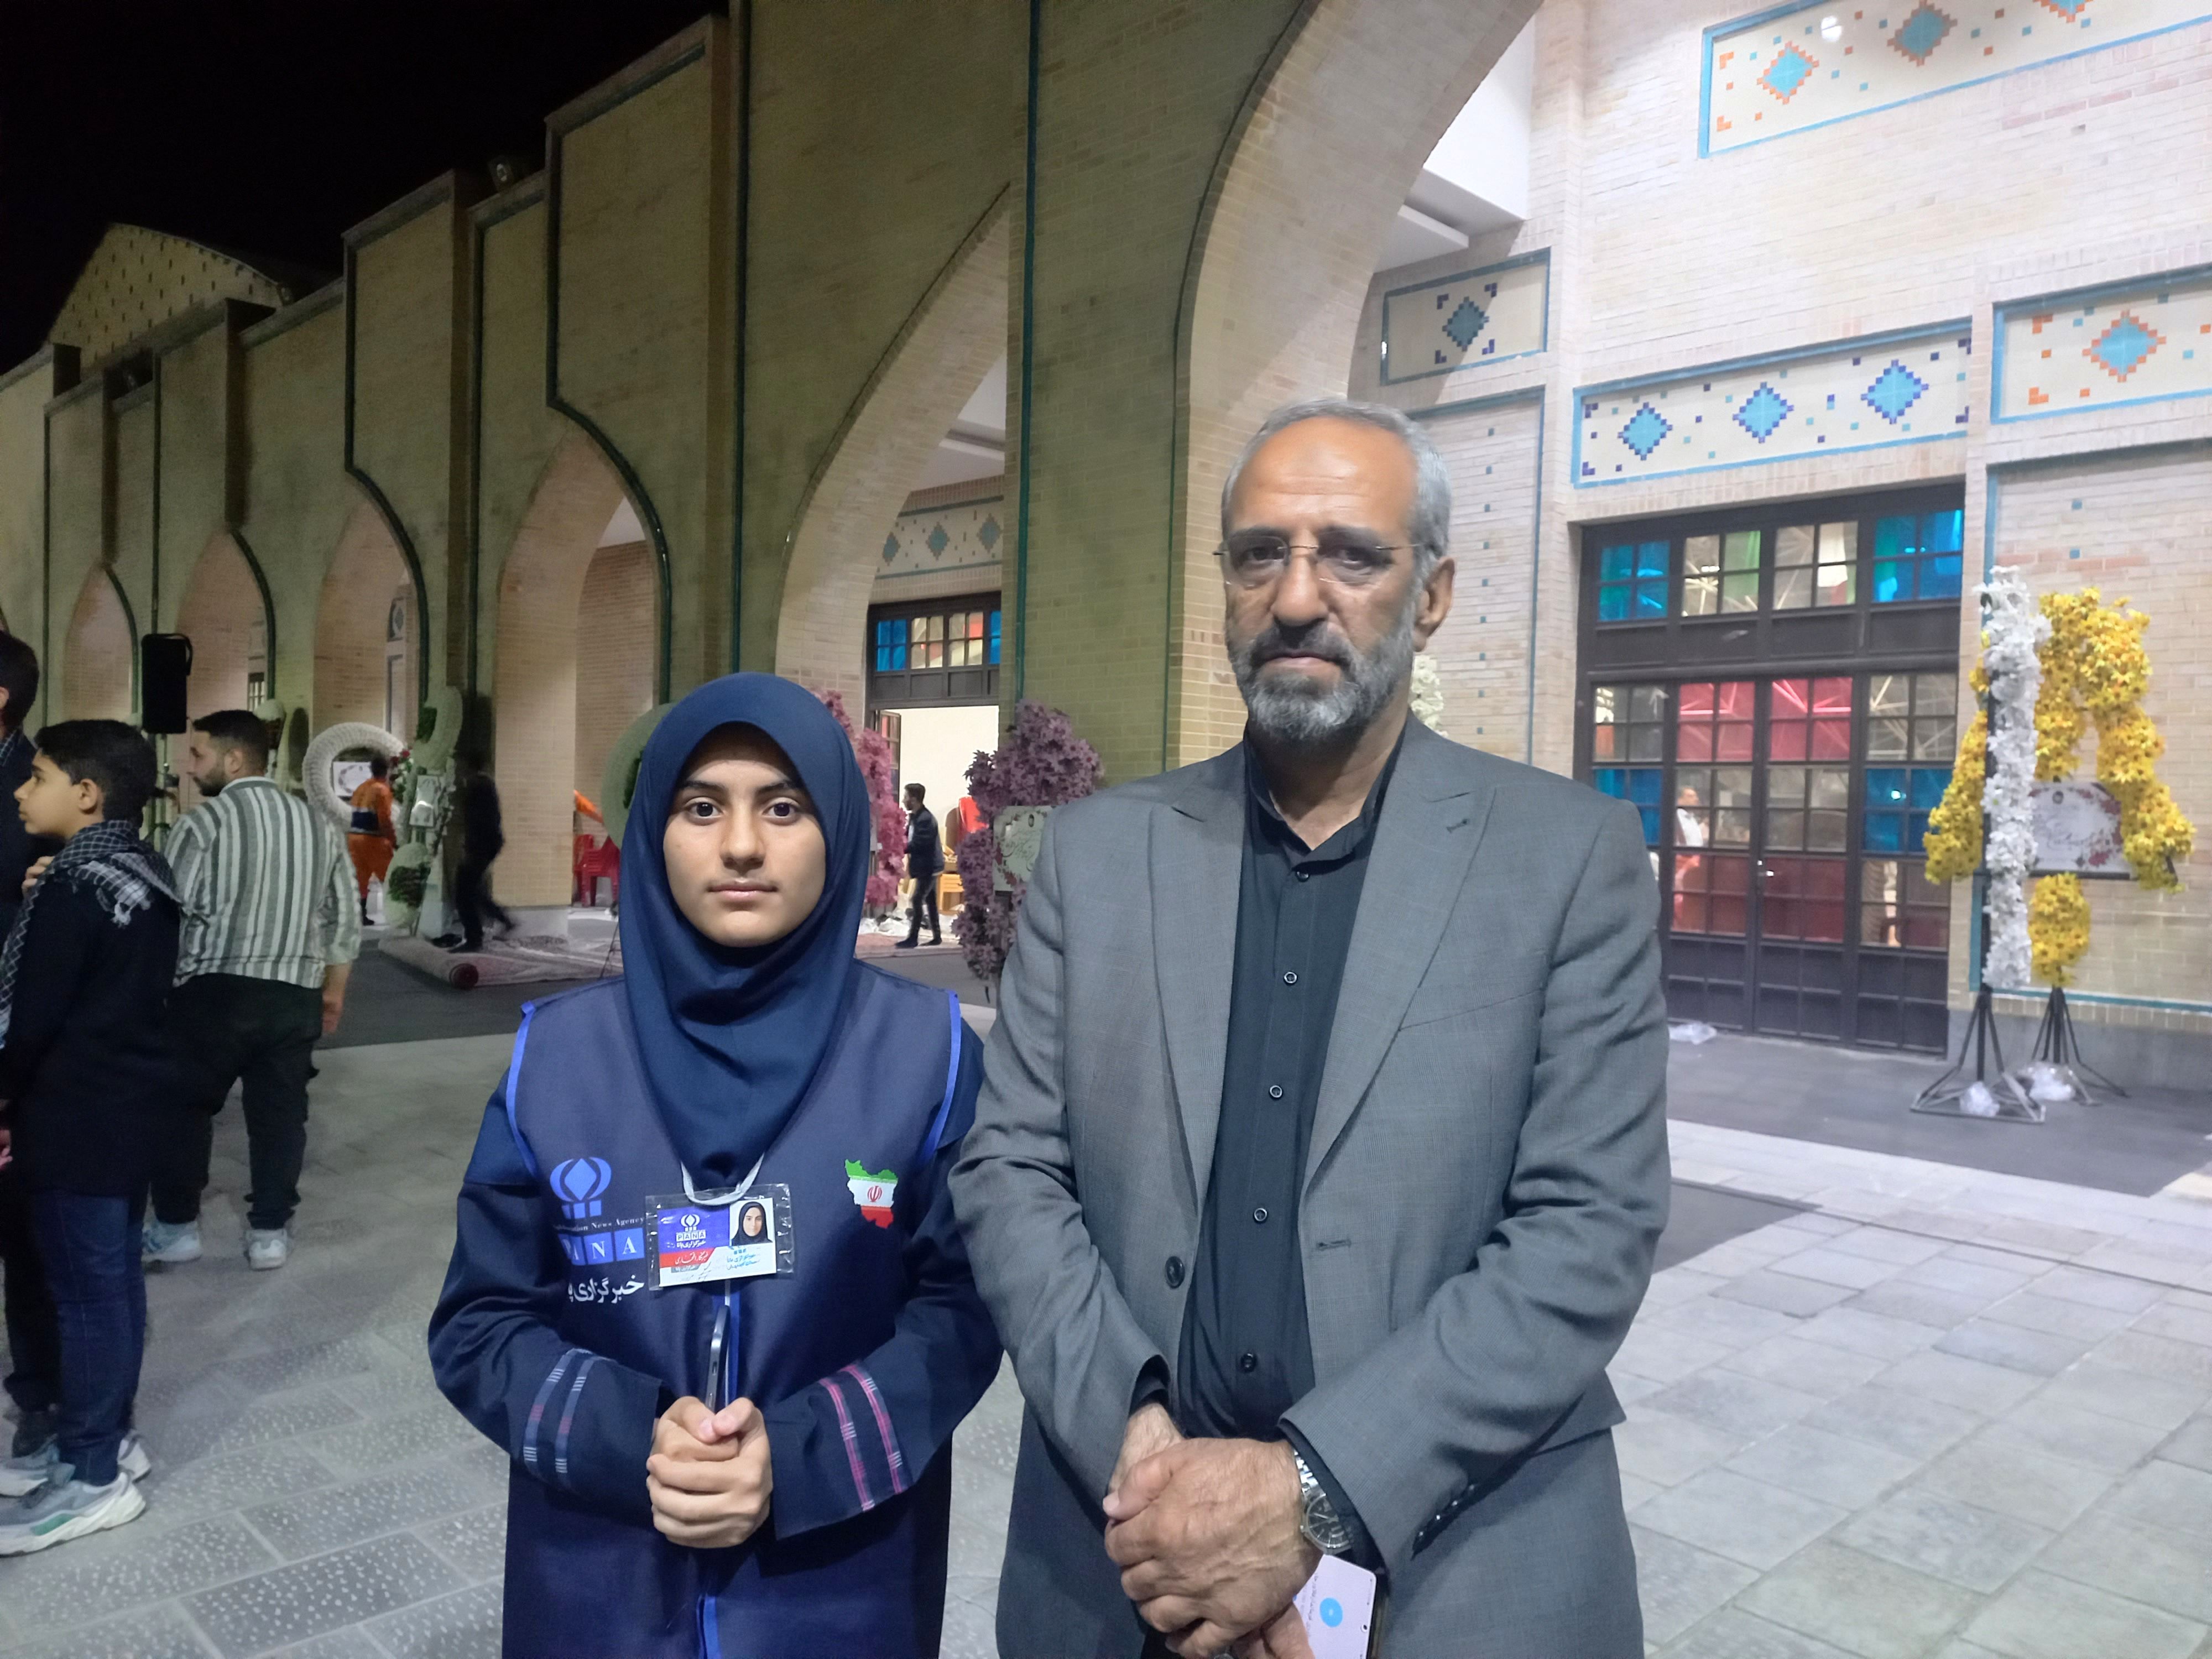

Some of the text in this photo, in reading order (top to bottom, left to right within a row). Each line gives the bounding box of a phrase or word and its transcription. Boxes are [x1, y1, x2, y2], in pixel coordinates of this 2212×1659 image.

[615, 1218, 644, 1227] Agency
[677, 1232, 705, 1240] PANA
[573, 1274, 645, 1304] خبرگزاری
